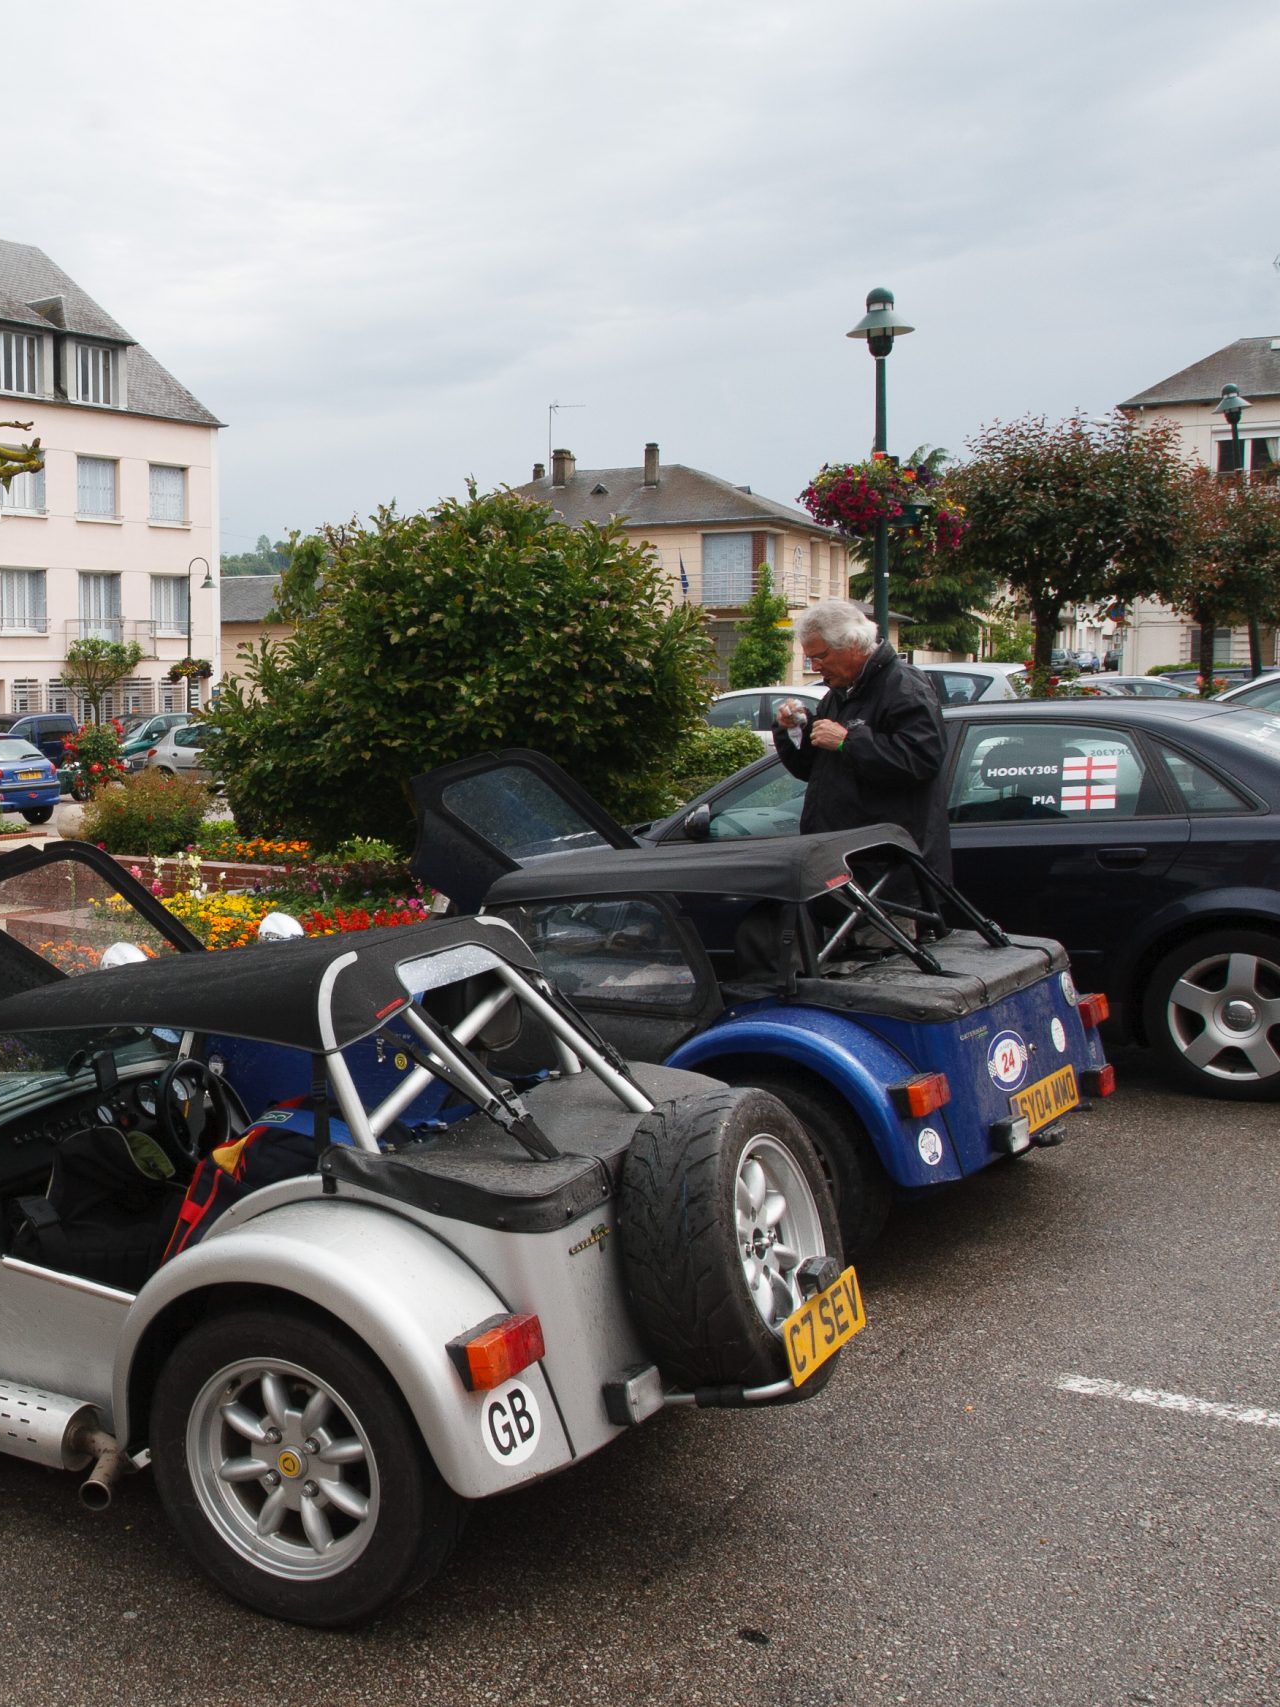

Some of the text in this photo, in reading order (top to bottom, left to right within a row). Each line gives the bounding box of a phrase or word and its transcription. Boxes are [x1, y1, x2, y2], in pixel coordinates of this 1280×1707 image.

[987, 765, 1058, 777] HOOKY305
[1032, 795, 1056, 805] PIA
[1002, 1049, 1015, 1073] 24
[789, 1275, 859, 1374] C7 SEV
[488, 1388, 535, 1456] GB
